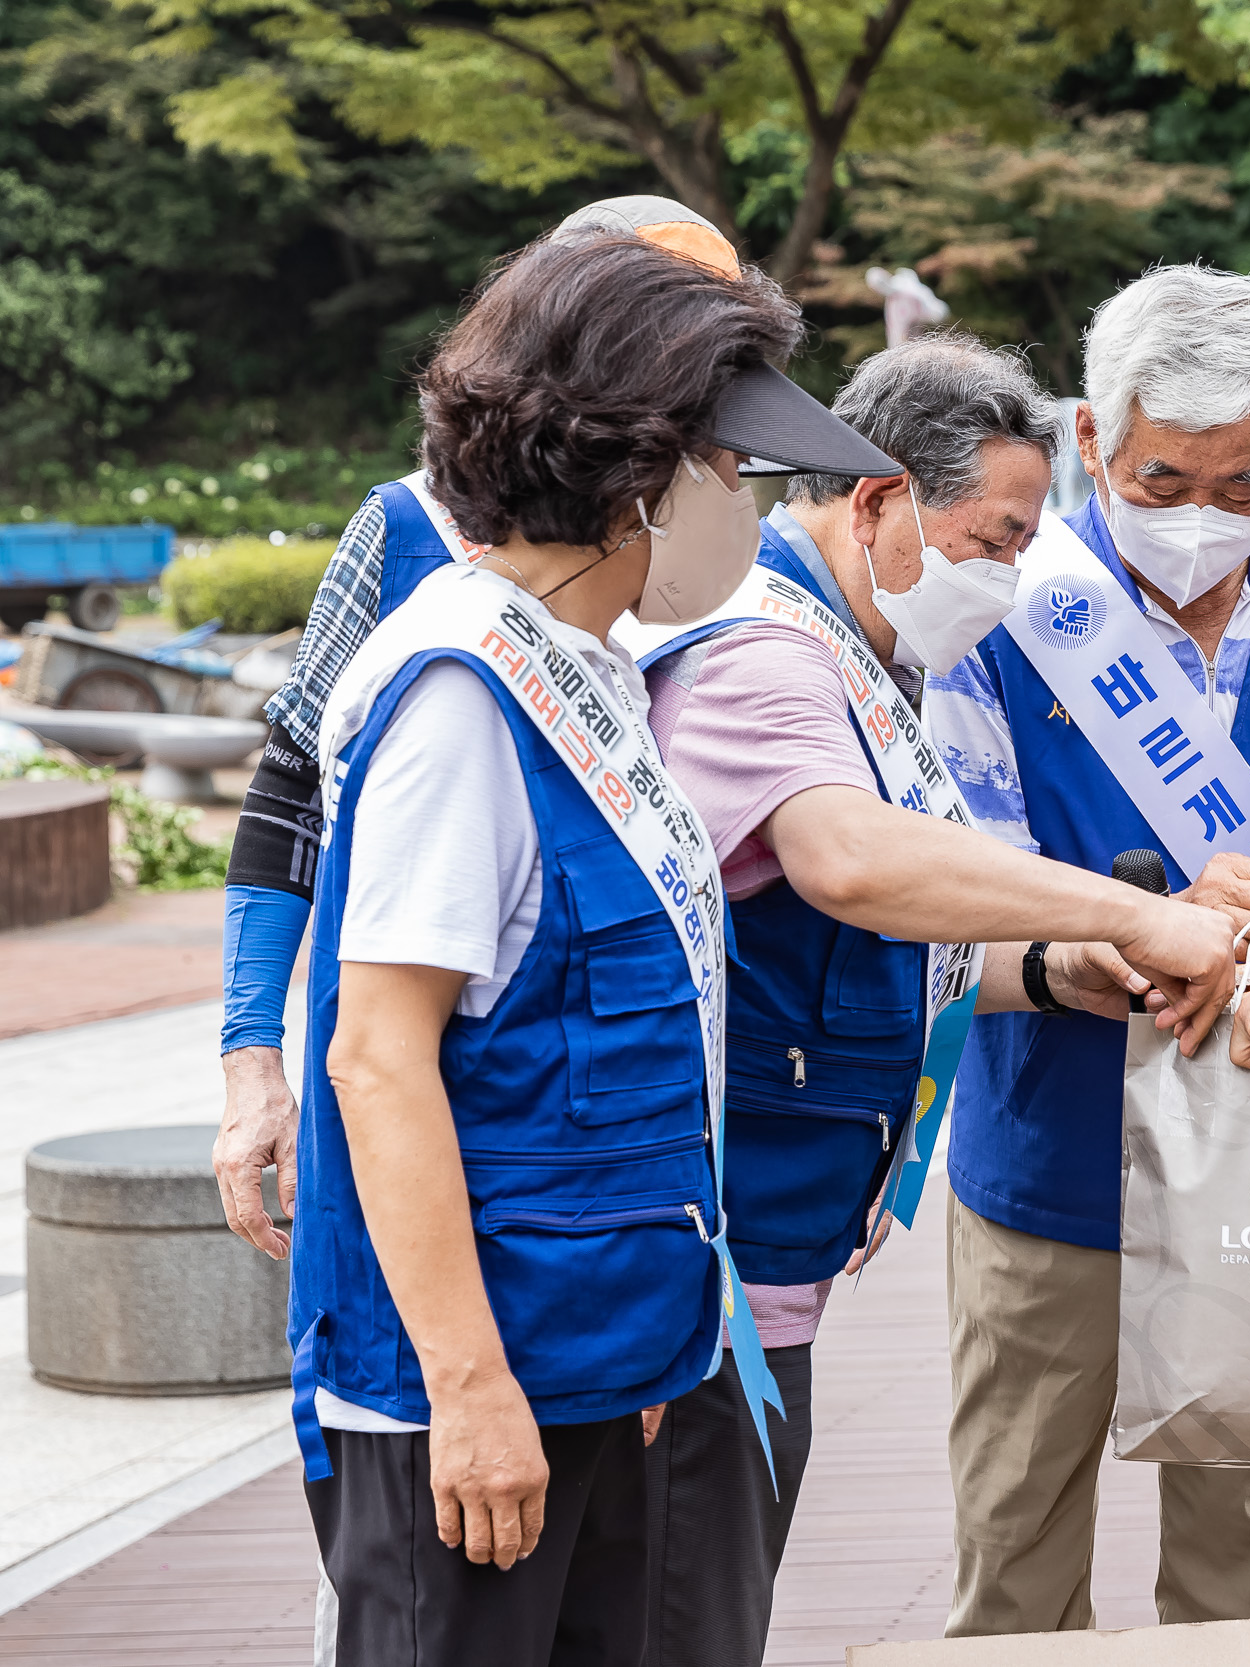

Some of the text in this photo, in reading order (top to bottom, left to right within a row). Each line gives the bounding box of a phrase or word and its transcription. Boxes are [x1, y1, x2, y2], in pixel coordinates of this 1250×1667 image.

[480, 630, 632, 820] 코로나19
[500, 604, 618, 747] 여름철
[617, 685, 635, 715] LOVE
[634, 723, 650, 753] LOVE
[651, 762, 668, 792] LOVE
[760, 597, 894, 748] 코로나19
[767, 578, 943, 785] 여름철 행락
